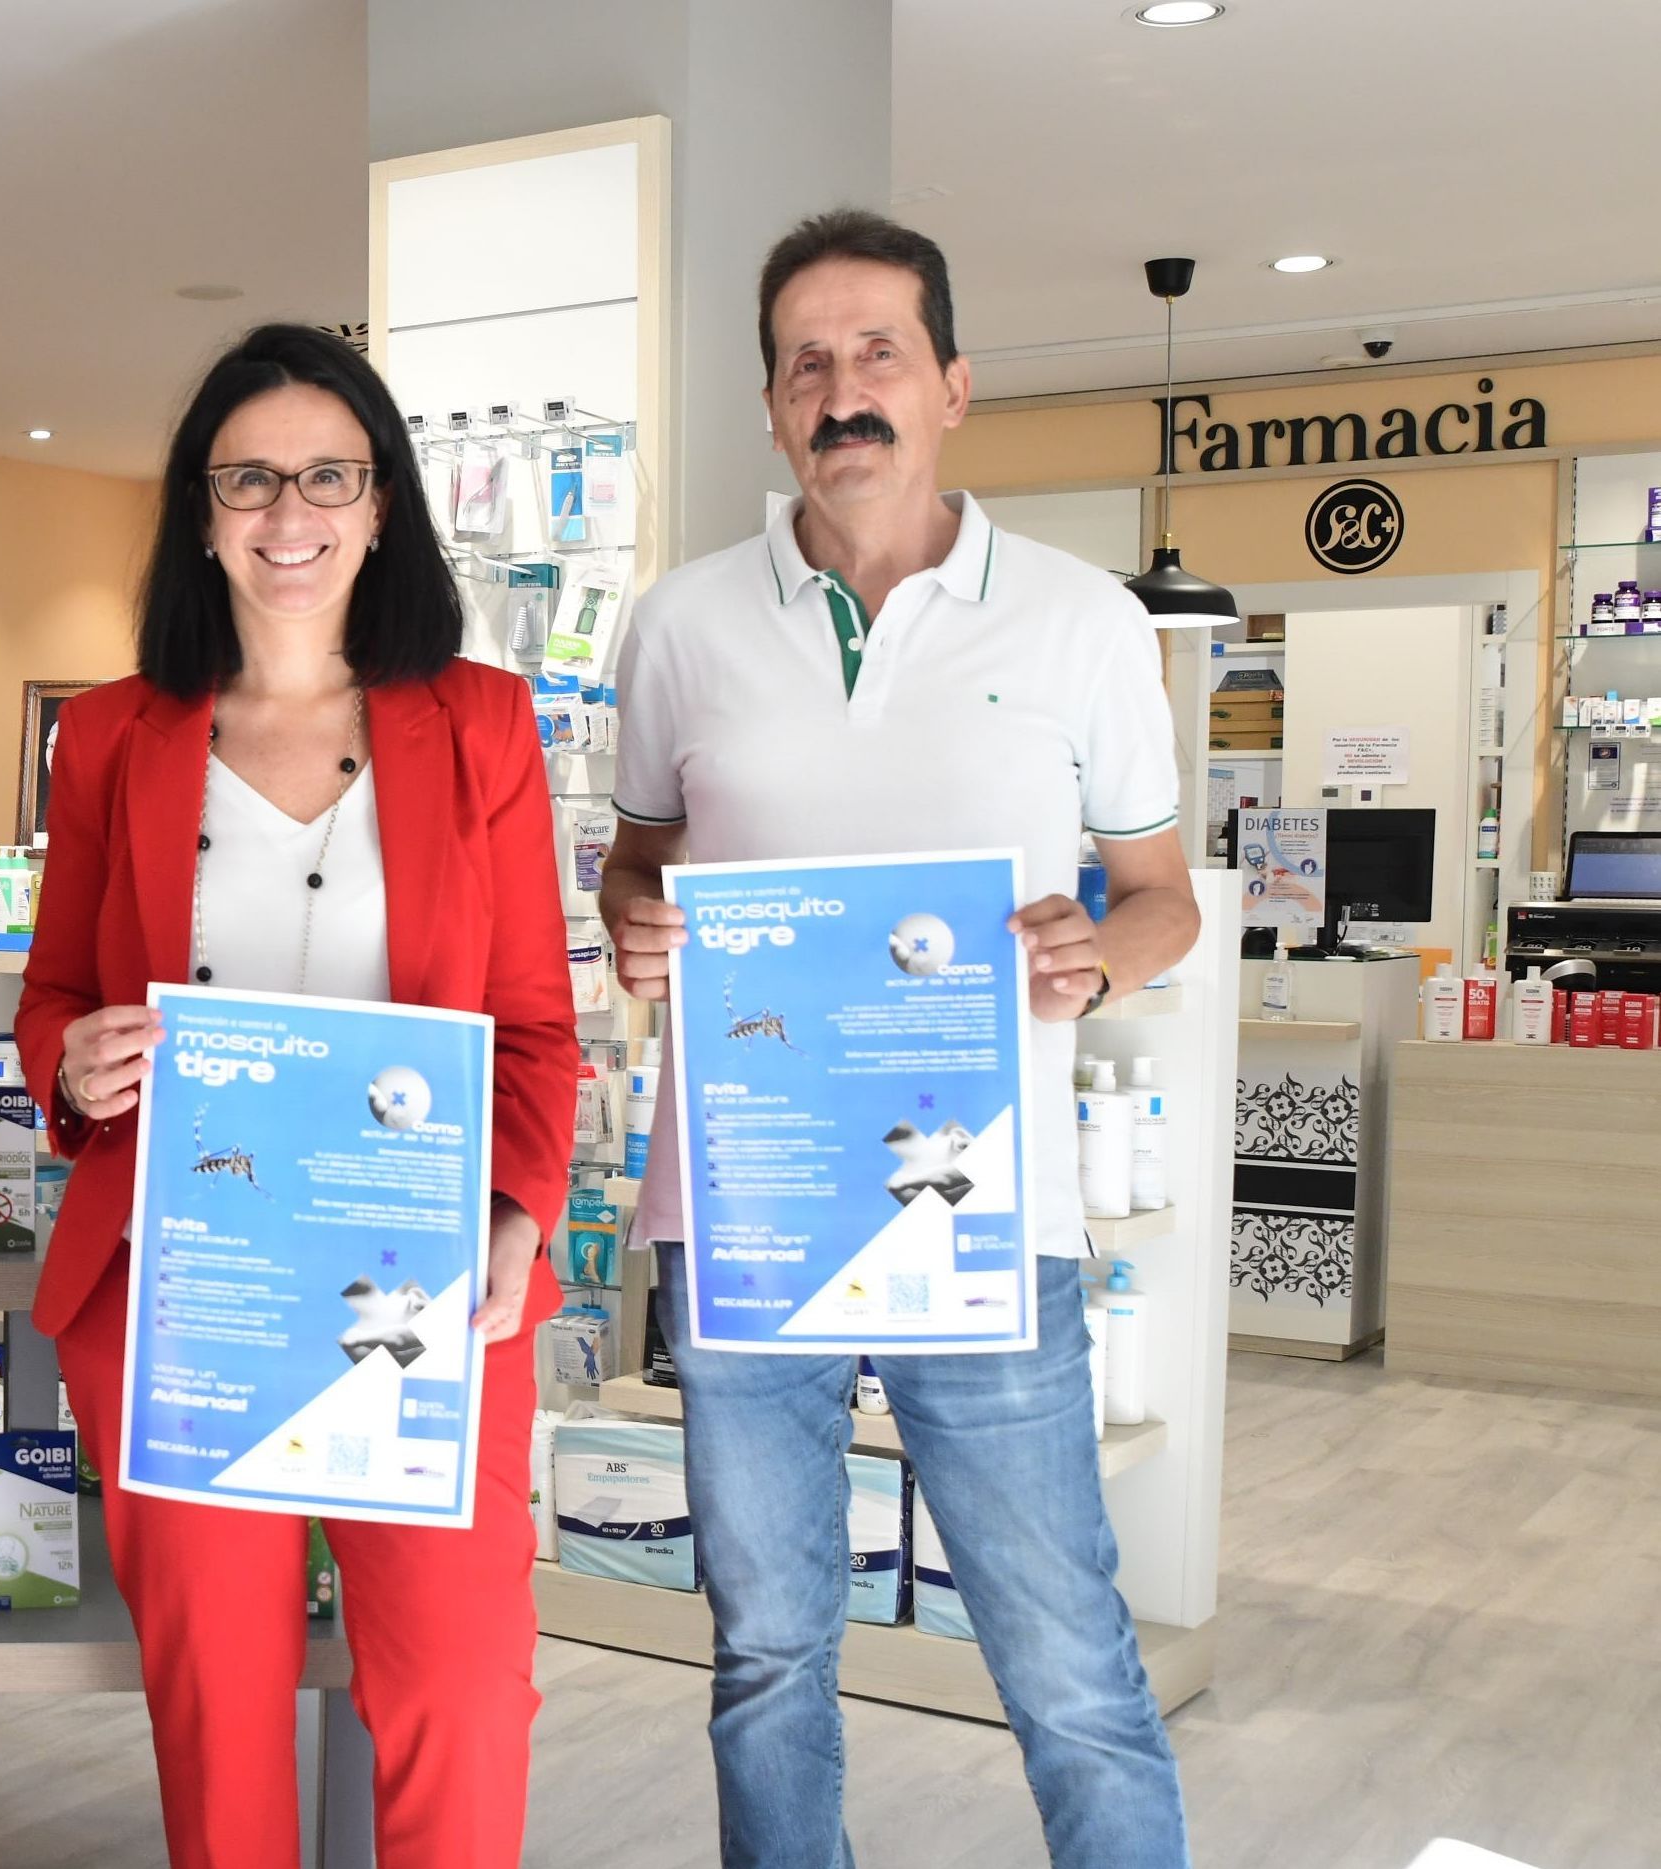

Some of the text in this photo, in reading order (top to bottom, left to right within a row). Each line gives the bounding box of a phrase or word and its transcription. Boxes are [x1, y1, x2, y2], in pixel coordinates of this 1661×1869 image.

[1152, 377, 1547, 475] Farmacia
[580, 825, 610, 836] Nexcare
[1245, 817, 1319, 832] DIABETES
[696, 896, 845, 922] mosquito
[698, 922, 796, 955] tigre
[938, 962, 992, 977] Como
[1468, 988, 1490, 1000] 50%
[176, 1028, 330, 1058] mosquito
[174, 1049, 276, 1087] tigre
[703, 1082, 749, 1096] Evita
[410, 1120, 463, 1137] Como
[161, 1216, 208, 1233] Evita
[709, 1233, 812, 1246] mosquito tigre?
[713, 1296, 794, 1308] DESCARGA A APP
[150, 1373, 256, 1396] mosquito tigre?
[15, 1447, 71, 1465] GOIBI
[146, 1438, 230, 1459] DESCARGA A APP
[606, 1463, 628, 1473] ABS
[587, 1473, 650, 1485] Empapadores
[20, 1503, 72, 1518] NATURE
[650, 1522, 665, 1534] 20
[57, 1560, 73, 1570] 12h
[850, 1553, 866, 1566] 20
[850, 1580, 875, 1589] medica
